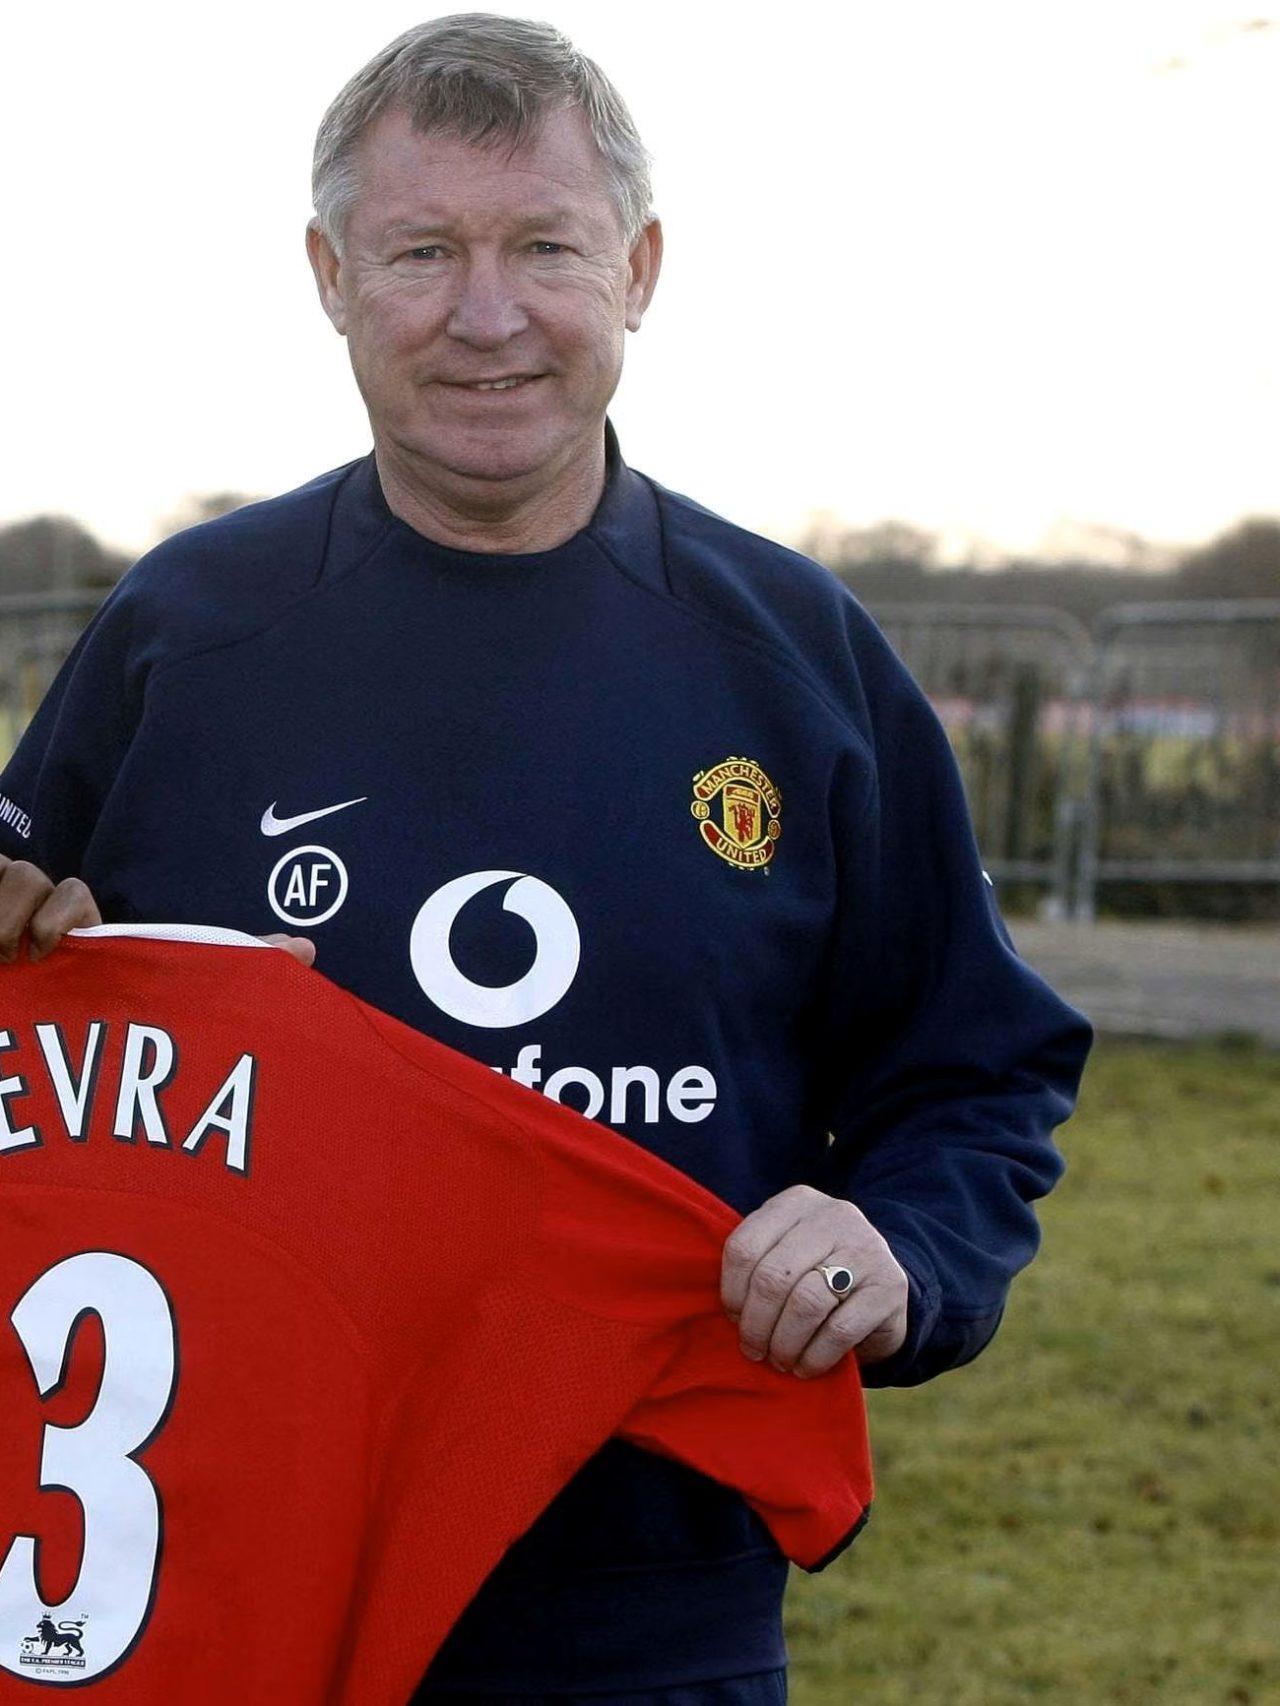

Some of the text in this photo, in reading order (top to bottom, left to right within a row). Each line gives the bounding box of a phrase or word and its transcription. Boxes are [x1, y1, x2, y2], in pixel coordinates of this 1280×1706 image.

[701, 764, 778, 863] MANCHESTER UNITED
[283, 863, 332, 907] AF
[489, 1044, 718, 1124] fone
